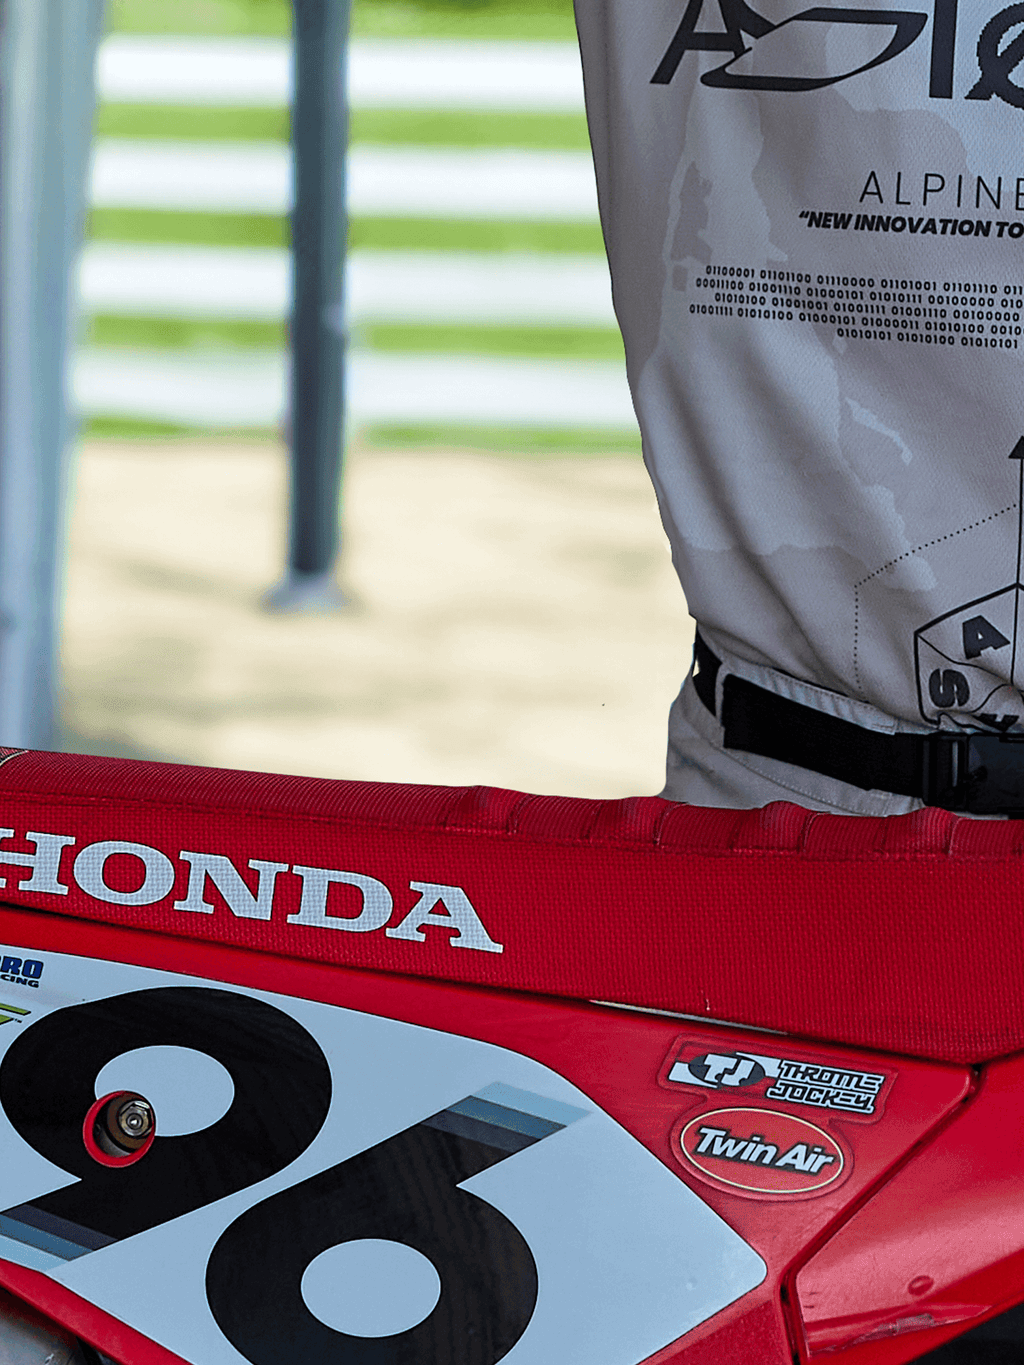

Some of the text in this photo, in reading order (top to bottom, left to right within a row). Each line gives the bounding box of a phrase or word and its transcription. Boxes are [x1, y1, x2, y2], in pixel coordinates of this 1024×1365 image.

[853, 213, 992, 238] INNOVATION
[996, 220, 1024, 239] TO
[695, 277, 745, 292] 00011100
[748, 281, 802, 297] 01001110
[805, 286, 865, 301] 01000101
[868, 290, 923, 305] 01010111
[927, 294, 995, 308] 00100000
[705, 264, 756, 279] 01100001
[759, 269, 812, 285] 01101100
[816, 274, 876, 289] 01110000
[880, 278, 937, 292] 01101001
[942, 281, 998, 295] 01101110
[688, 303, 734, 317] 01001111
[736, 307, 794, 322] 01010100
[798, 311, 856, 326] 01000101
[860, 316, 920, 331] 01000011
[924, 320, 985, 335] 01010100
[714, 291, 767, 307] 01010100
[771, 296, 829, 312] 01001001
[832, 301, 886, 316] 01001111
[890, 305, 948, 319] 01001110
[952, 308, 1020, 323] 00100000
[836, 326, 892, 342] 01010101
[896, 331, 956, 346] 01010100
[960, 335, 1018, 350] 01010101
[0, 827, 504, 954] HONDA
[0, 955, 44, 979] RO
[696, 1127, 835, 1174] Twin Air
[0, 986, 592, 1365] 96
